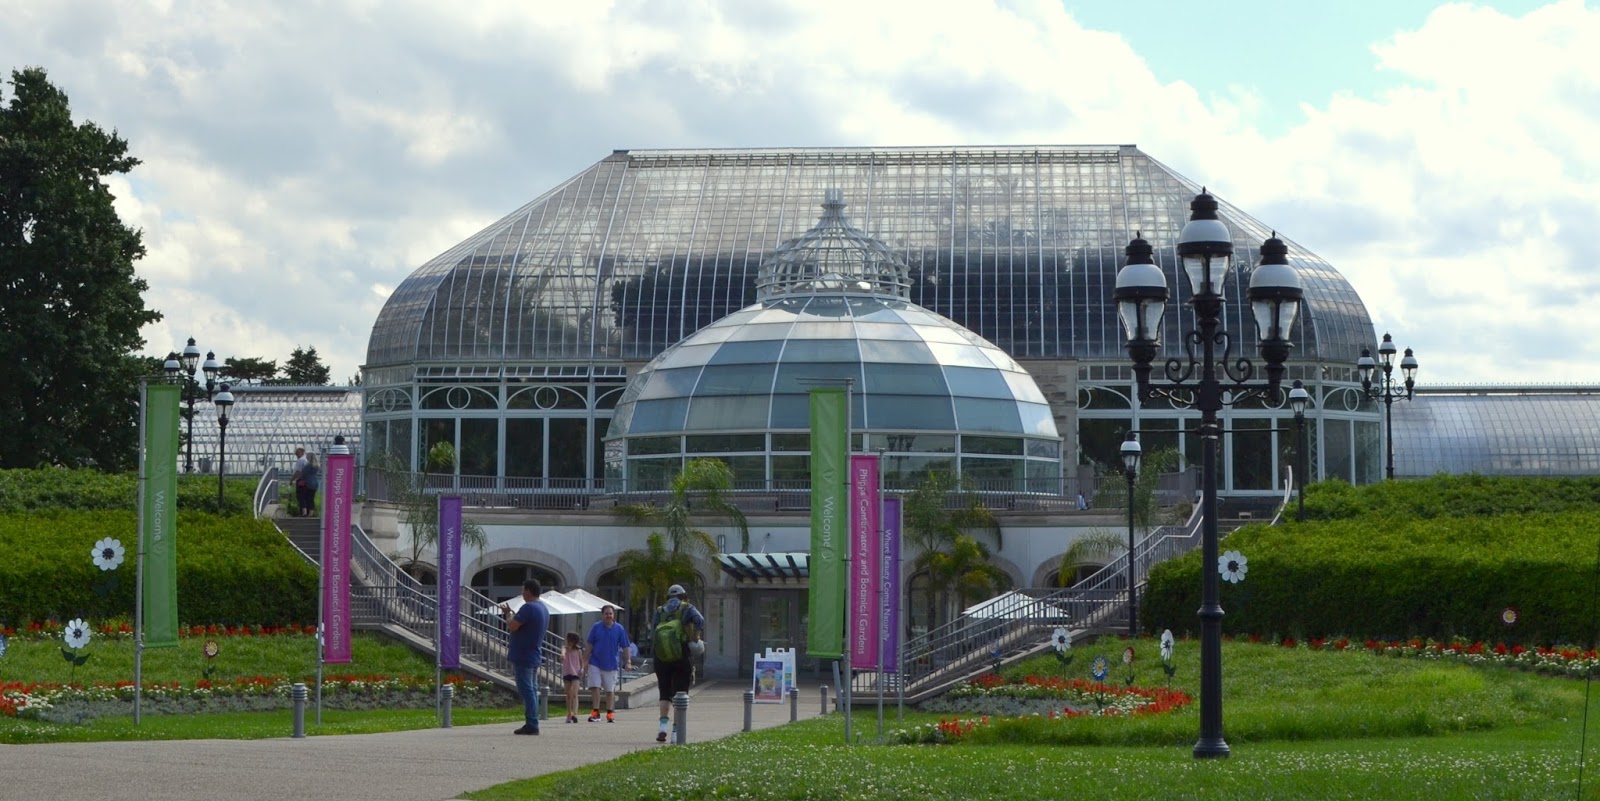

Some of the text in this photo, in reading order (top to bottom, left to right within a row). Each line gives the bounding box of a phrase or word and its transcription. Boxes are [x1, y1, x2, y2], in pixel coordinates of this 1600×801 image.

[333, 468, 344, 495] Phipps
[154, 490, 165, 541] Welcome
[331, 498, 342, 554] Conservatory
[823, 496, 834, 547] Welcome
[446, 527, 454, 552] Where
[332, 557, 340, 572] and
[445, 553, 453, 577] Beauty
[858, 469, 869, 655] Phipps Conservatory and Botanical Gardens
[883, 529, 892, 641] Where Beauty Comes Naturally
[332, 614, 341, 650] Gardens
[445, 605, 453, 638] Naturally
